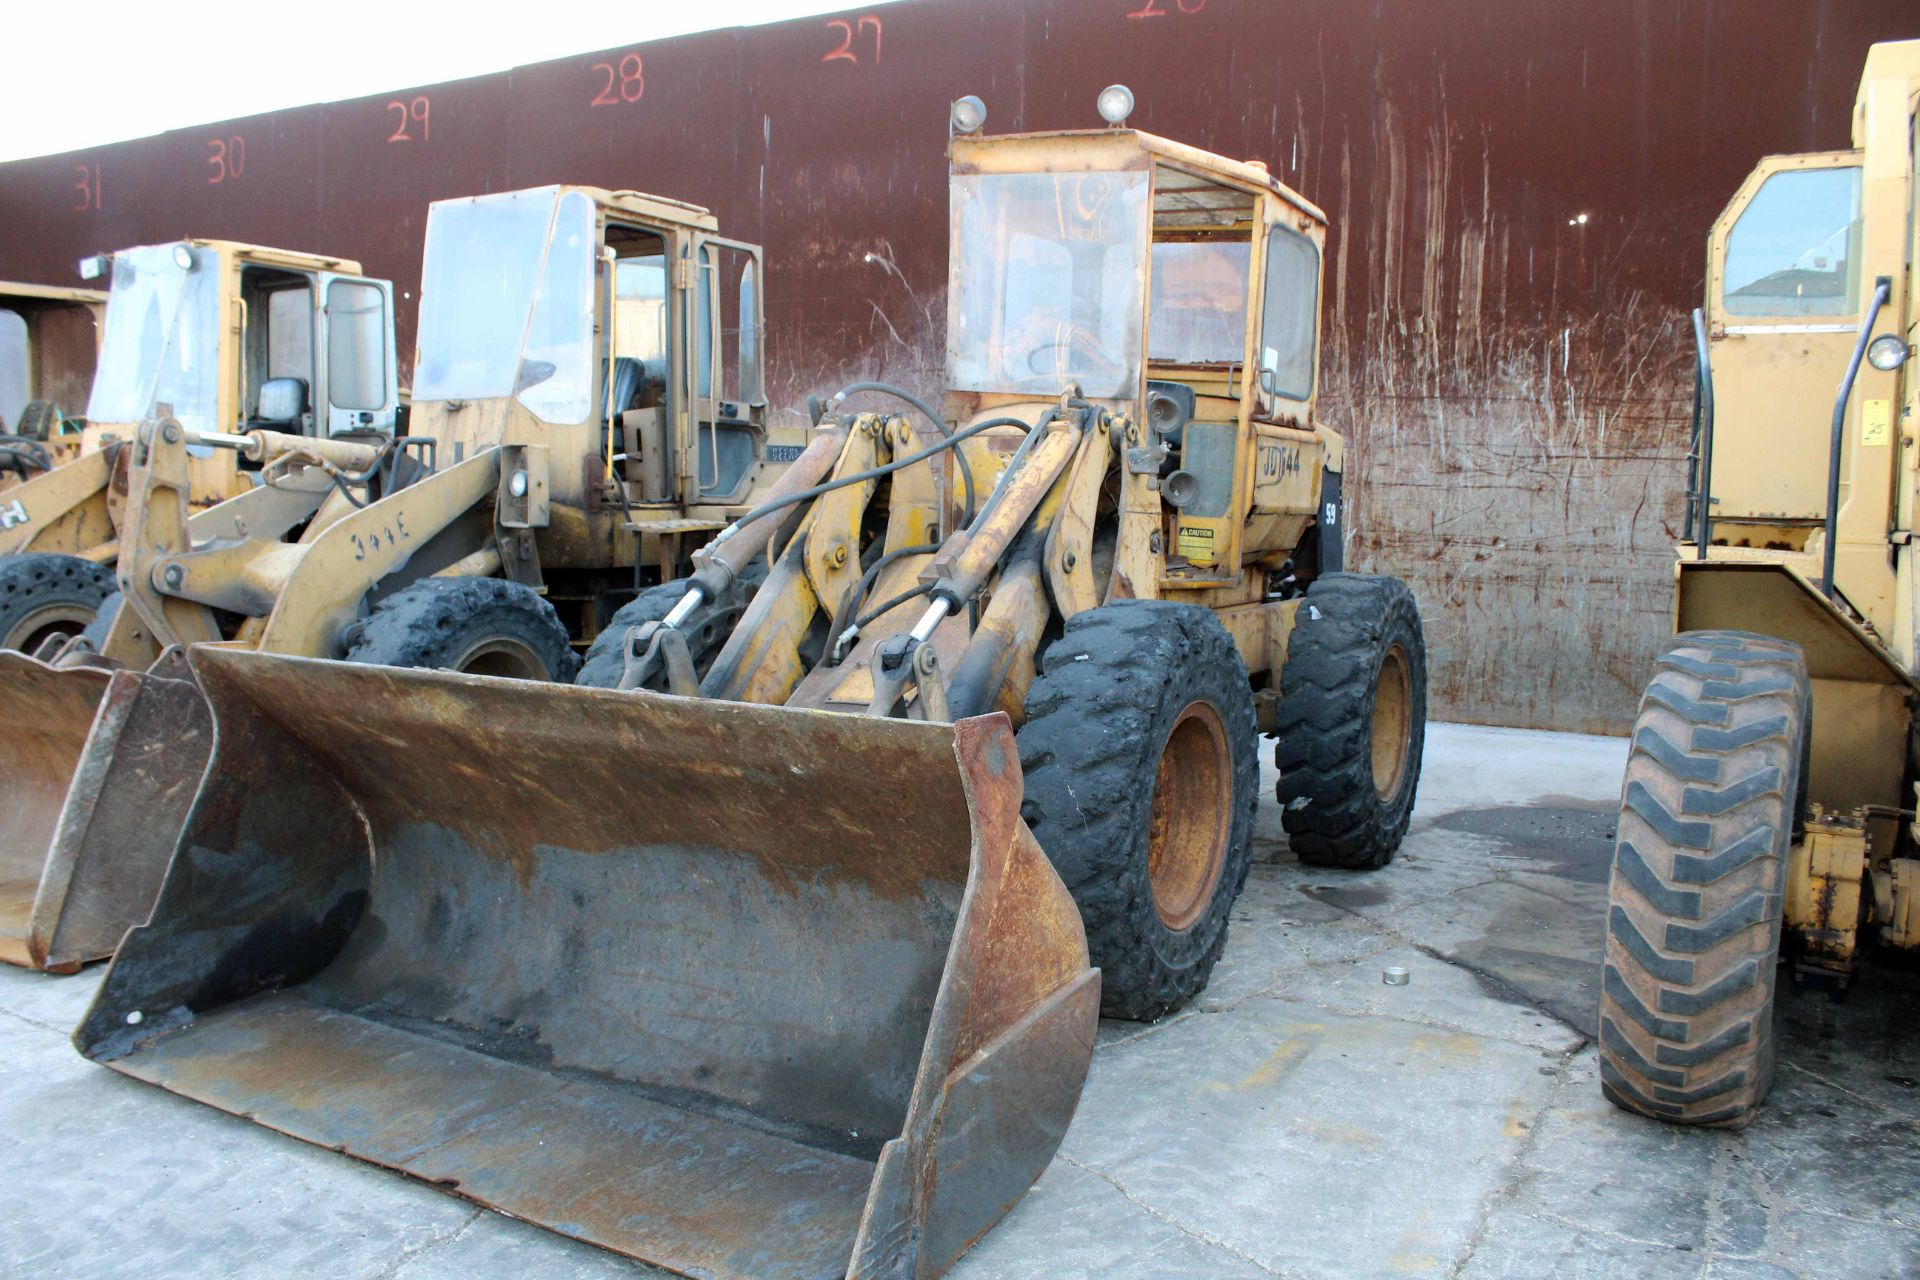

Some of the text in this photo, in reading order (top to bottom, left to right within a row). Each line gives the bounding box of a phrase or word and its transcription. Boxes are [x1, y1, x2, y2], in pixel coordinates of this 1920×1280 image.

[821, 13, 882, 65] 27
[591, 53, 644, 107] 28
[387, 96, 429, 142] 29
[208, 136, 245, 184] 30
[73, 162, 101, 211] 31
[1188, 529, 1212, 537] CAUTION
